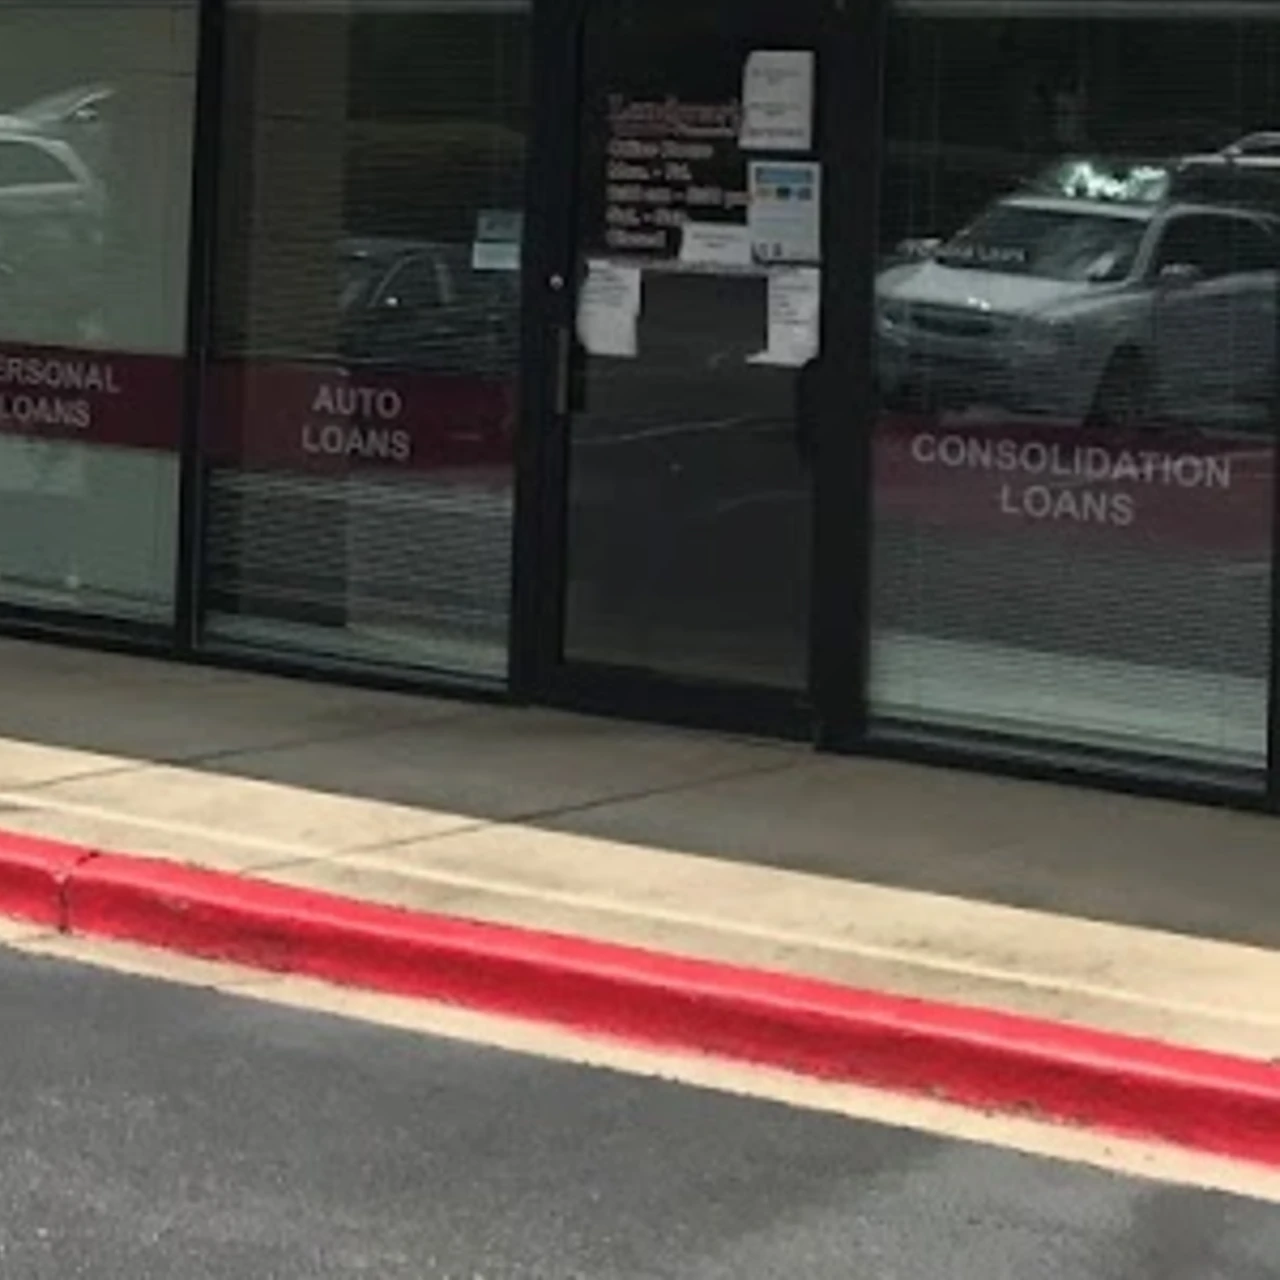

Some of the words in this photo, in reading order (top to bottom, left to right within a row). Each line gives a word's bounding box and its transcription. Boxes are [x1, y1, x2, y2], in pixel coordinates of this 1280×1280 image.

[312, 384, 403, 420] AUTO
[301, 424, 411, 461] LOANS
[910, 433, 1232, 489] CONSOLIDATION
[999, 483, 1136, 527] LOANS
